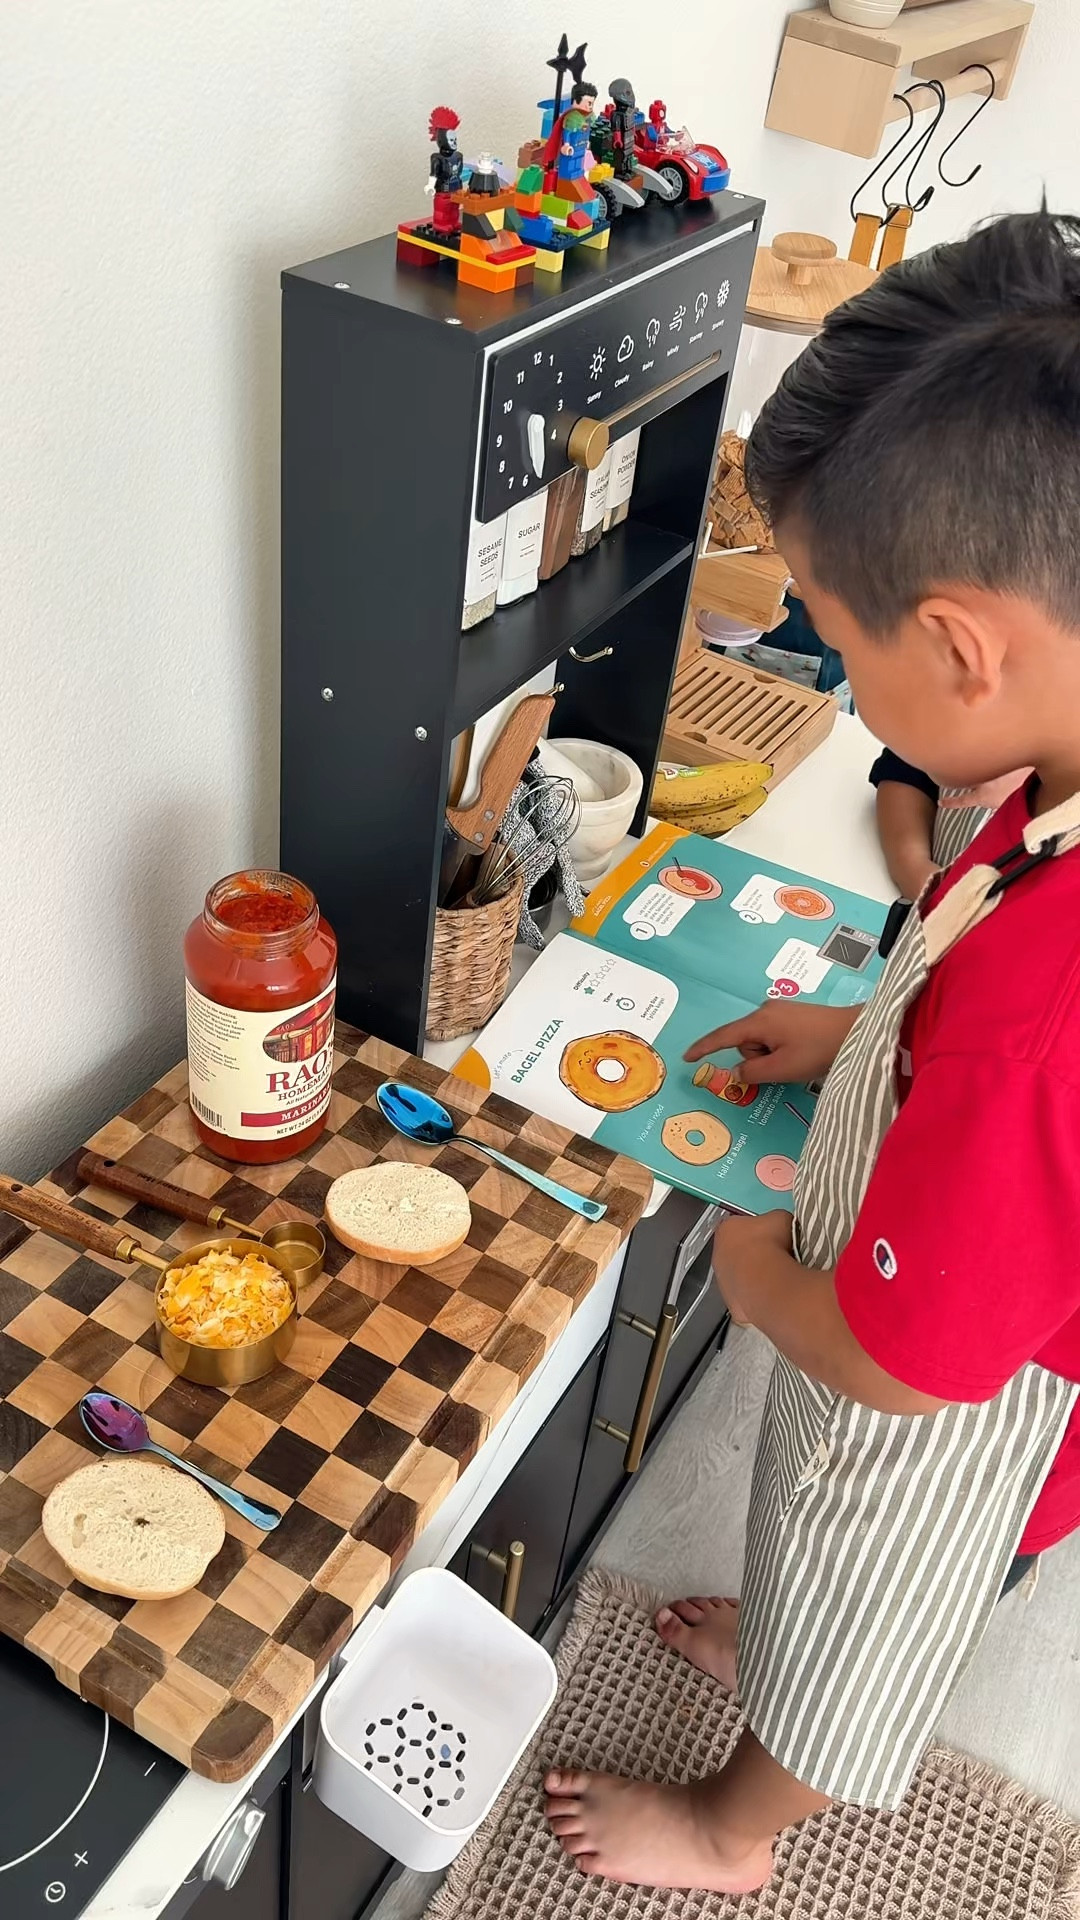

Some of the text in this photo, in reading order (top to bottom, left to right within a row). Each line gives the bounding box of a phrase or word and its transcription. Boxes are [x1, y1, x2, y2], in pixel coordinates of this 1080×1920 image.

[533, 351, 543, 366] 12
[549, 354, 554, 367] 1
[516, 370, 525, 385] 11
[556, 371, 563, 384] 2
[614, 374, 630, 388] Cloudy
[557, 399, 563, 412] 3
[586, 391, 602, 405] Sunny
[503, 399, 513, 414] 10
[496, 434, 503, 448] 9
[550, 429, 557, 440] 4
[498, 460, 505, 473] 8
[508, 476, 514, 490] 7
[522, 474, 529, 487] 6
[518, 522, 541, 539] SUGAR
[478, 537, 503, 558] SESAME
[480, 551, 499, 567] SEEDS
[573, 971, 591, 991] Difficulty
[779, 983, 793, 993] 3
[602, 992, 614, 1003] Time
[640, 1003, 654, 1018] Serving
[510, 1019, 564, 1084] BAGEL PIZZA
[281, 1081, 331, 1121] MARINARA
[748, 1084, 775, 1120] Tablespoon
[758, 1084, 786, 1126] tomato sauce
[276, 1127, 288, 1135] NET
[288, 1123, 298, 1132] WT
[636, 1103, 665, 1143] You will need
[716, 1163, 730, 1179] Half
[727, 1155, 735, 1165] of
[733, 1132, 748, 1153] bagel
